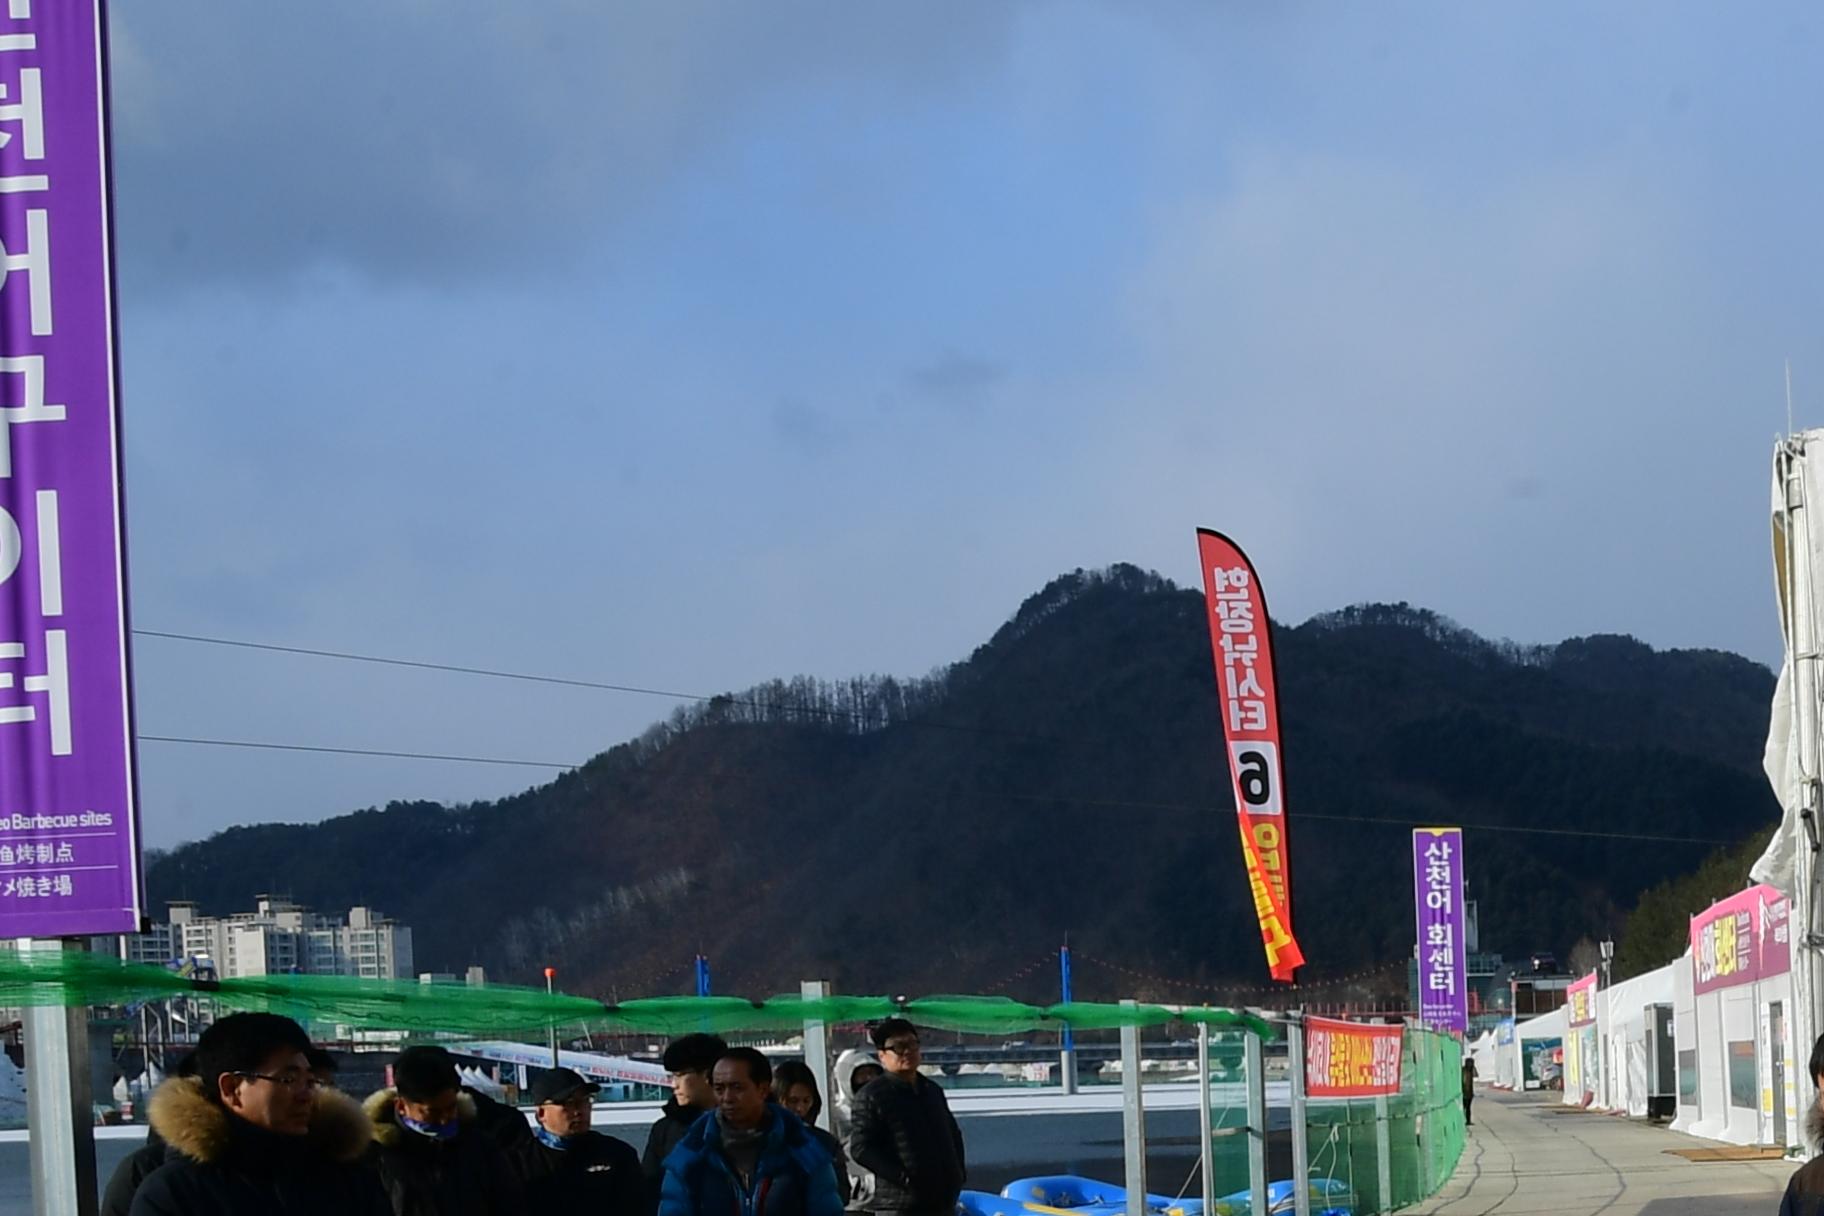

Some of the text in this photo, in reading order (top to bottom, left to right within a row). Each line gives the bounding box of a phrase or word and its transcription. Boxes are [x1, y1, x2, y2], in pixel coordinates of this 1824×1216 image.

[12, 812, 78, 830] Barbecue
[79, 809, 112, 826] sites
[1424, 842, 1453, 915] 산천어
[1426, 923, 1455, 996] 회센터
